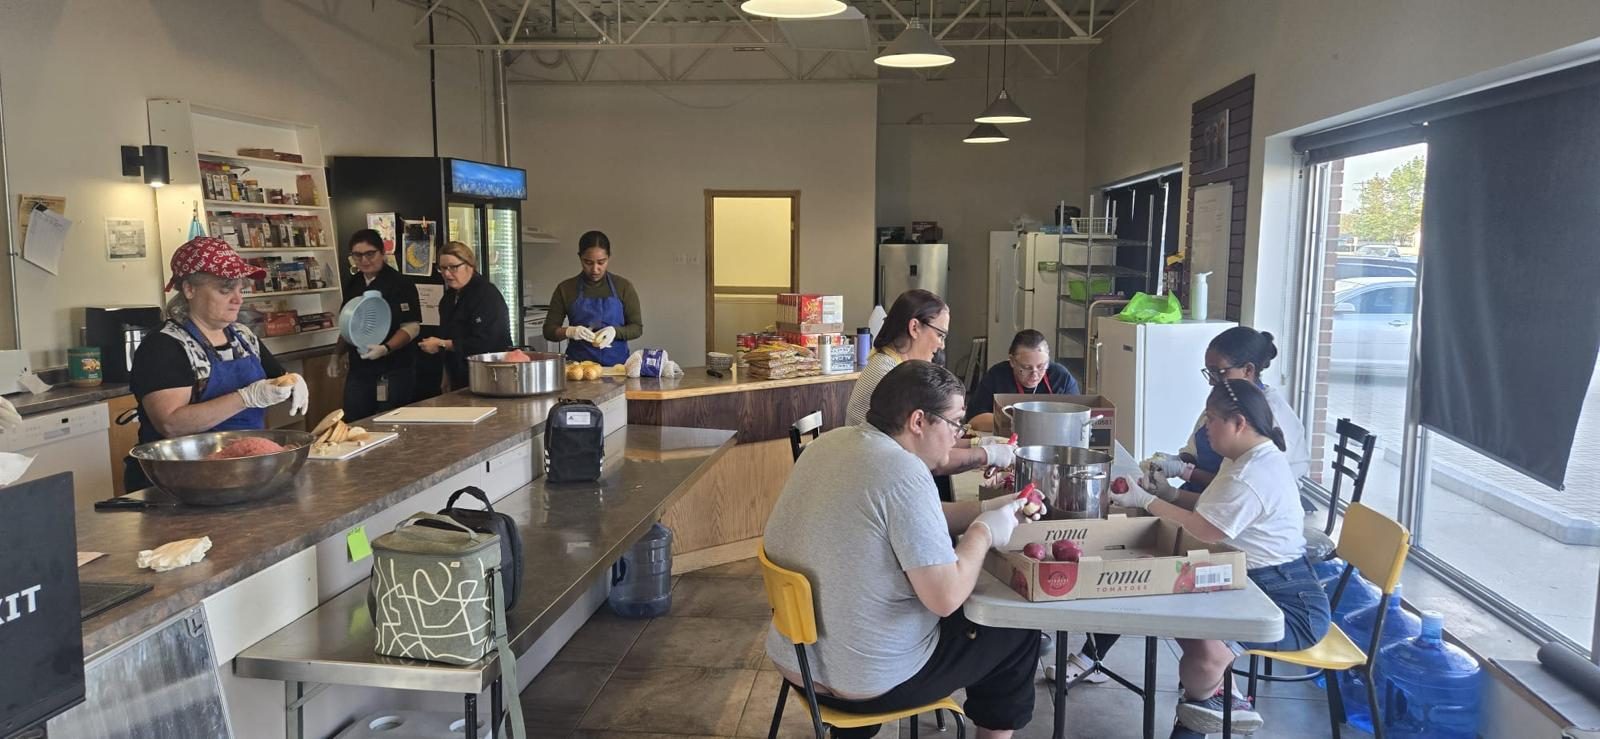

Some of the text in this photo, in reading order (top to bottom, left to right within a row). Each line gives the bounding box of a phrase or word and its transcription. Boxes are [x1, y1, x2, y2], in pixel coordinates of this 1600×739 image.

[1045, 528, 1088, 541] roma
[1096, 569, 1151, 585] roma
[0, 584, 41, 625] IT
